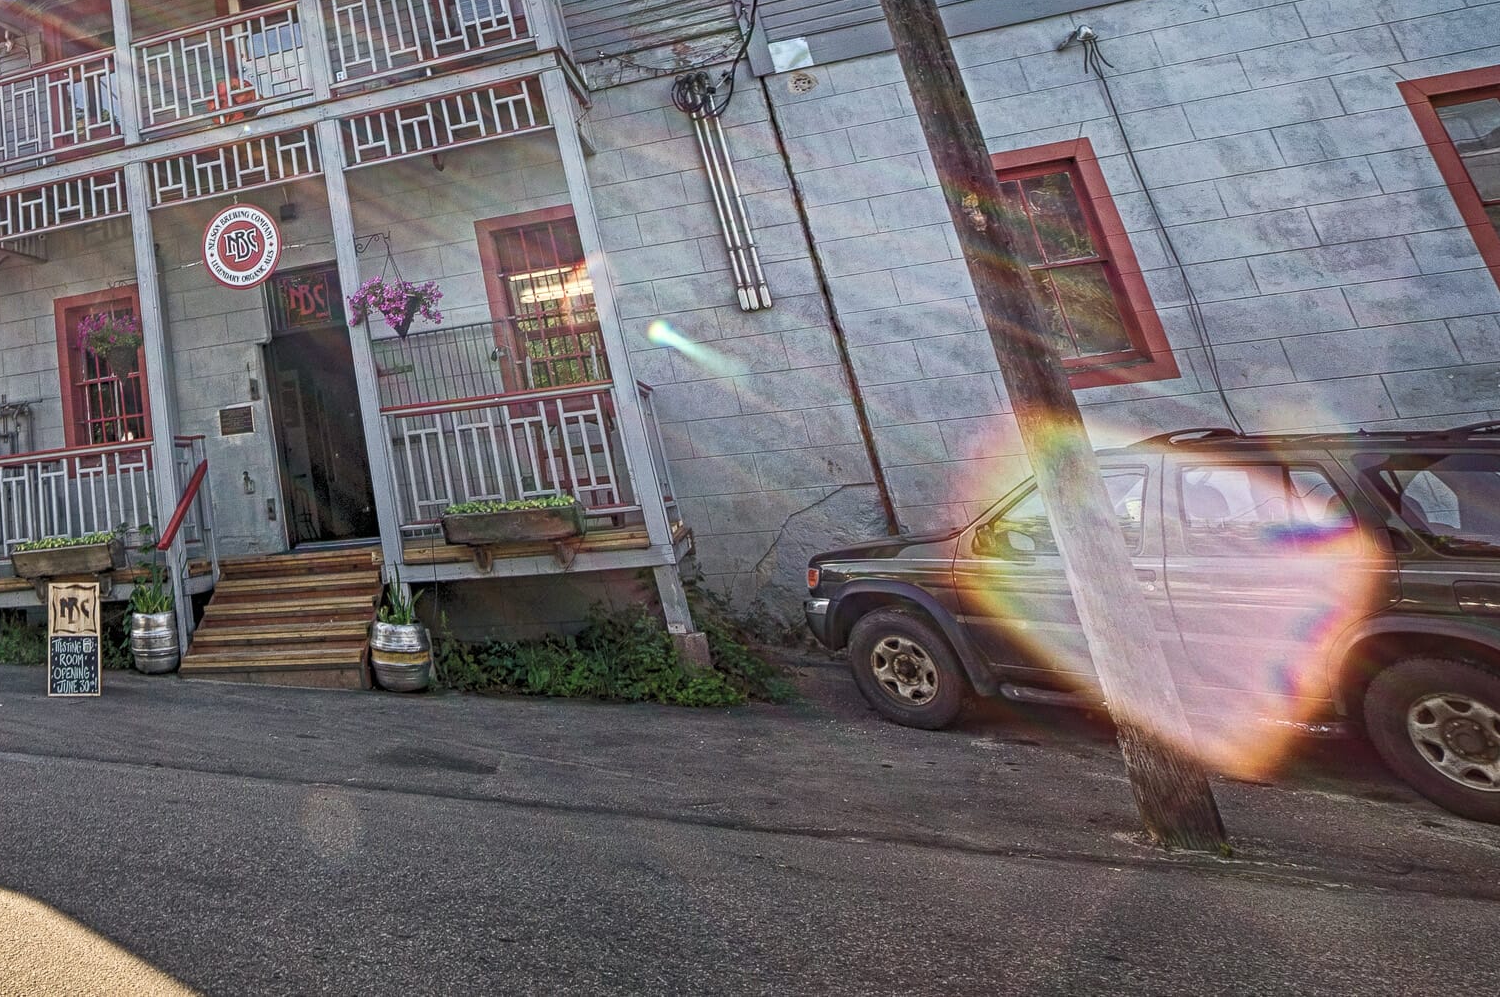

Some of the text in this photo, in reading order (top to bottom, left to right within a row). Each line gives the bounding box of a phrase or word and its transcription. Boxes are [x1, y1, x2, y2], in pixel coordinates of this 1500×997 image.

[208, 210, 274, 250] NELSON BREWING COMPANY
[211, 250, 275, 283] LEGENDARY ORGANIC ALES
[60, 654, 84, 667] ROOM
[53, 666, 90, 679] OPENING
[57, 679, 78, 693] JUNE
